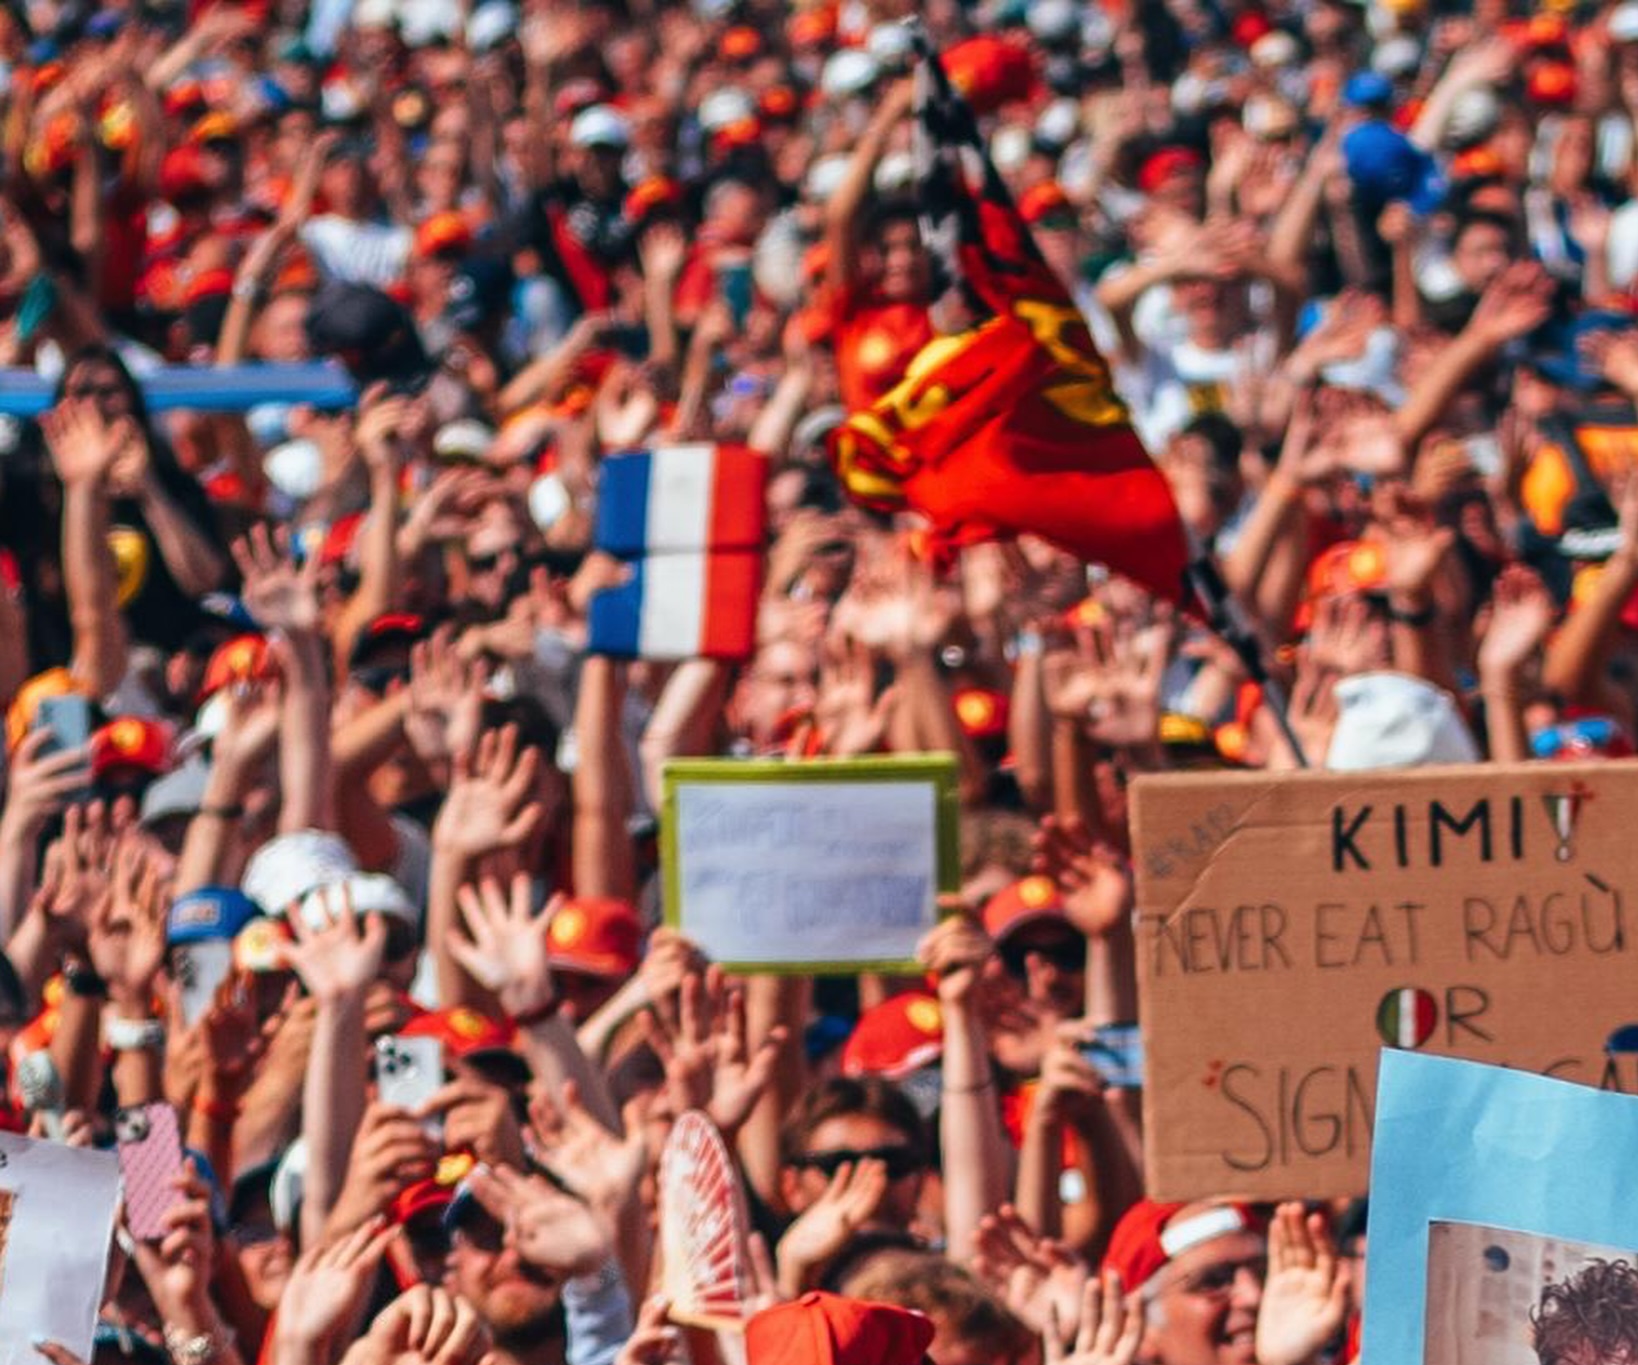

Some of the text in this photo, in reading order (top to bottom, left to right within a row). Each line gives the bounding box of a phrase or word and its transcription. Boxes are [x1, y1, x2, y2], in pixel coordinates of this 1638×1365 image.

[1142, 904, 1291, 977] NEVER
[1313, 903, 1425, 969] EAT
[1462, 872, 1624, 961] RAGÙ
